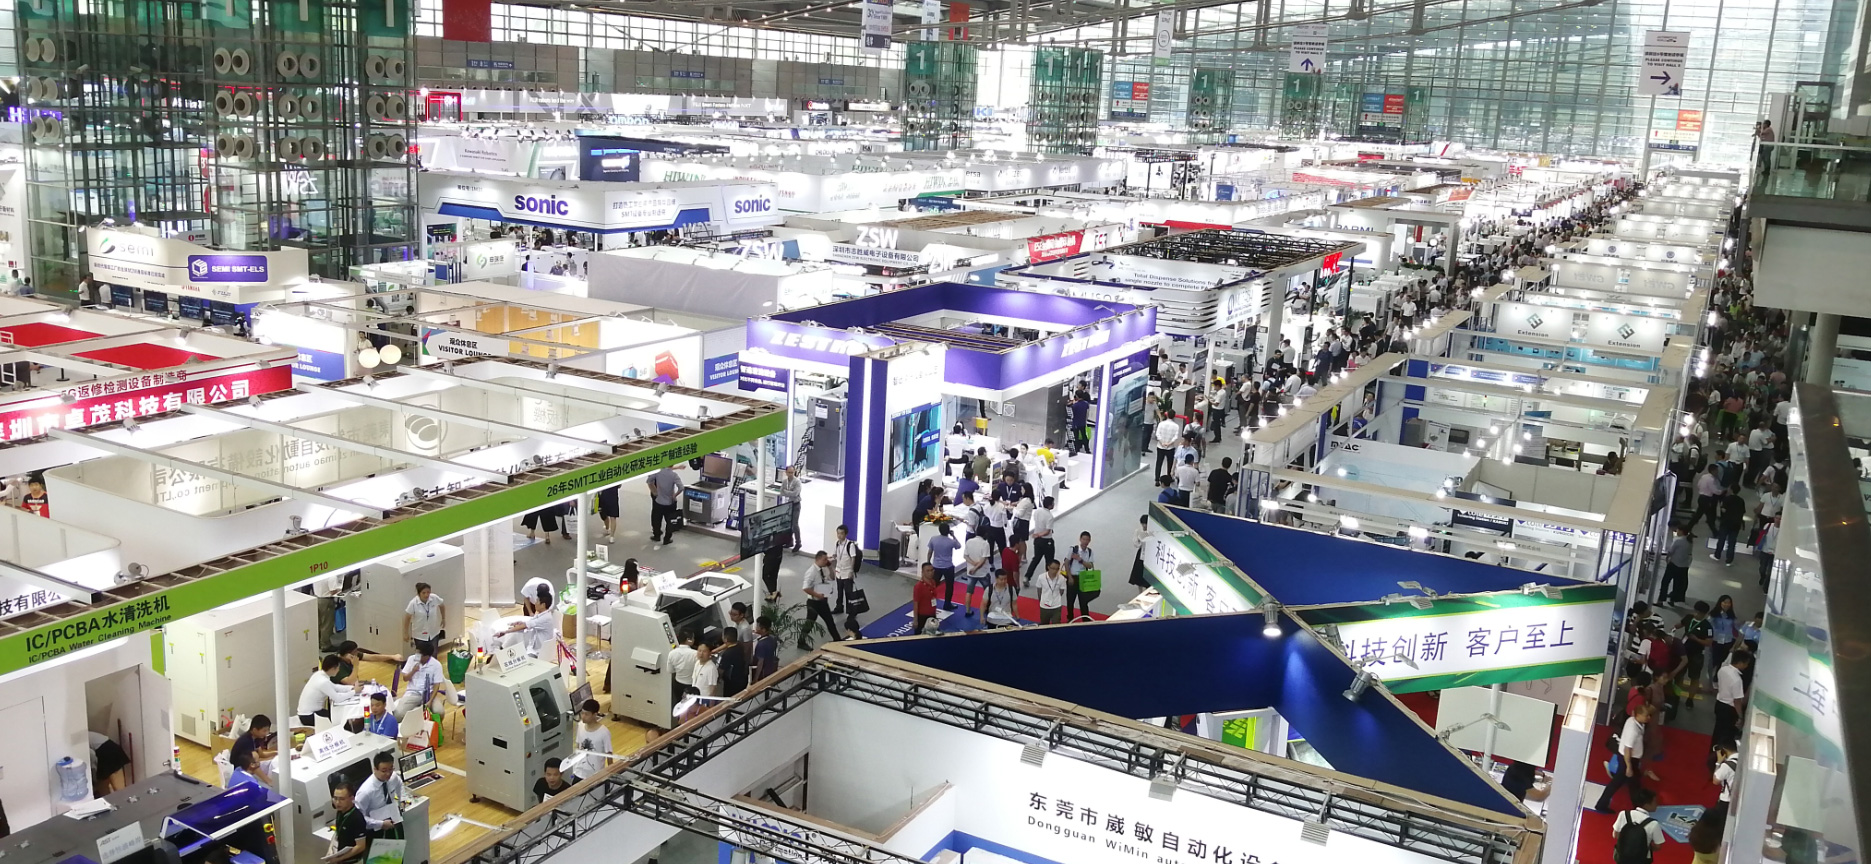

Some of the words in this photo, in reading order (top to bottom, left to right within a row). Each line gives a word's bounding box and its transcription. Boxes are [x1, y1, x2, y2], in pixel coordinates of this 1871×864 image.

[916, 49, 925, 70] 1
[1045, 56, 1054, 77] 1
[1076, 57, 1081, 78] 1
[1096, 59, 1100, 79] 1
[1201, 74, 1208, 88] 1
[1293, 78, 1300, 92] 1
[1414, 90, 1420, 100] 1
[514, 193, 569, 217] sonic
[734, 194, 771, 214] sonic
[854, 225, 898, 249] ZSW
[120, 243, 154, 257] semi
[740, 240, 784, 261] ZSW
[211, 265, 230, 273] SEMI
[231, 265, 265, 274] SMT-ELS
[1125, 278, 1143, 286] single
[1171, 283, 1200, 291] complete
[1149, 274, 1178, 283] Dispense
[1178, 277, 1207, 285] Solutions
[1517, 329, 1549, 338] Extension
[438, 344, 463, 356] VISITOR
[449, 337, 478, 350] 观众休息区
[1607, 340, 1641, 349] Extension
[714, 359, 738, 372] 观众休息区
[709, 372, 726, 380] VISITOR
[546, 441, 698, 498] 26年SMT工业自动化研发与生产制造经验
[309, 561, 329, 575] 1P10
[25, 594, 170, 652] IC/PCBA水清洗机
[29, 646, 66, 664] IC/PCBA
[69, 638, 94, 652] Water
[97, 624, 135, 643] Cleaning
[138, 613, 172, 630] Machine
[1465, 619, 1575, 658] 客户至上
[1028, 791, 1280, 864] 东莞市崴敏自动化设
[1027, 815, 1096, 844] Dongguan
[1105, 838, 1149, 860] WiMin
